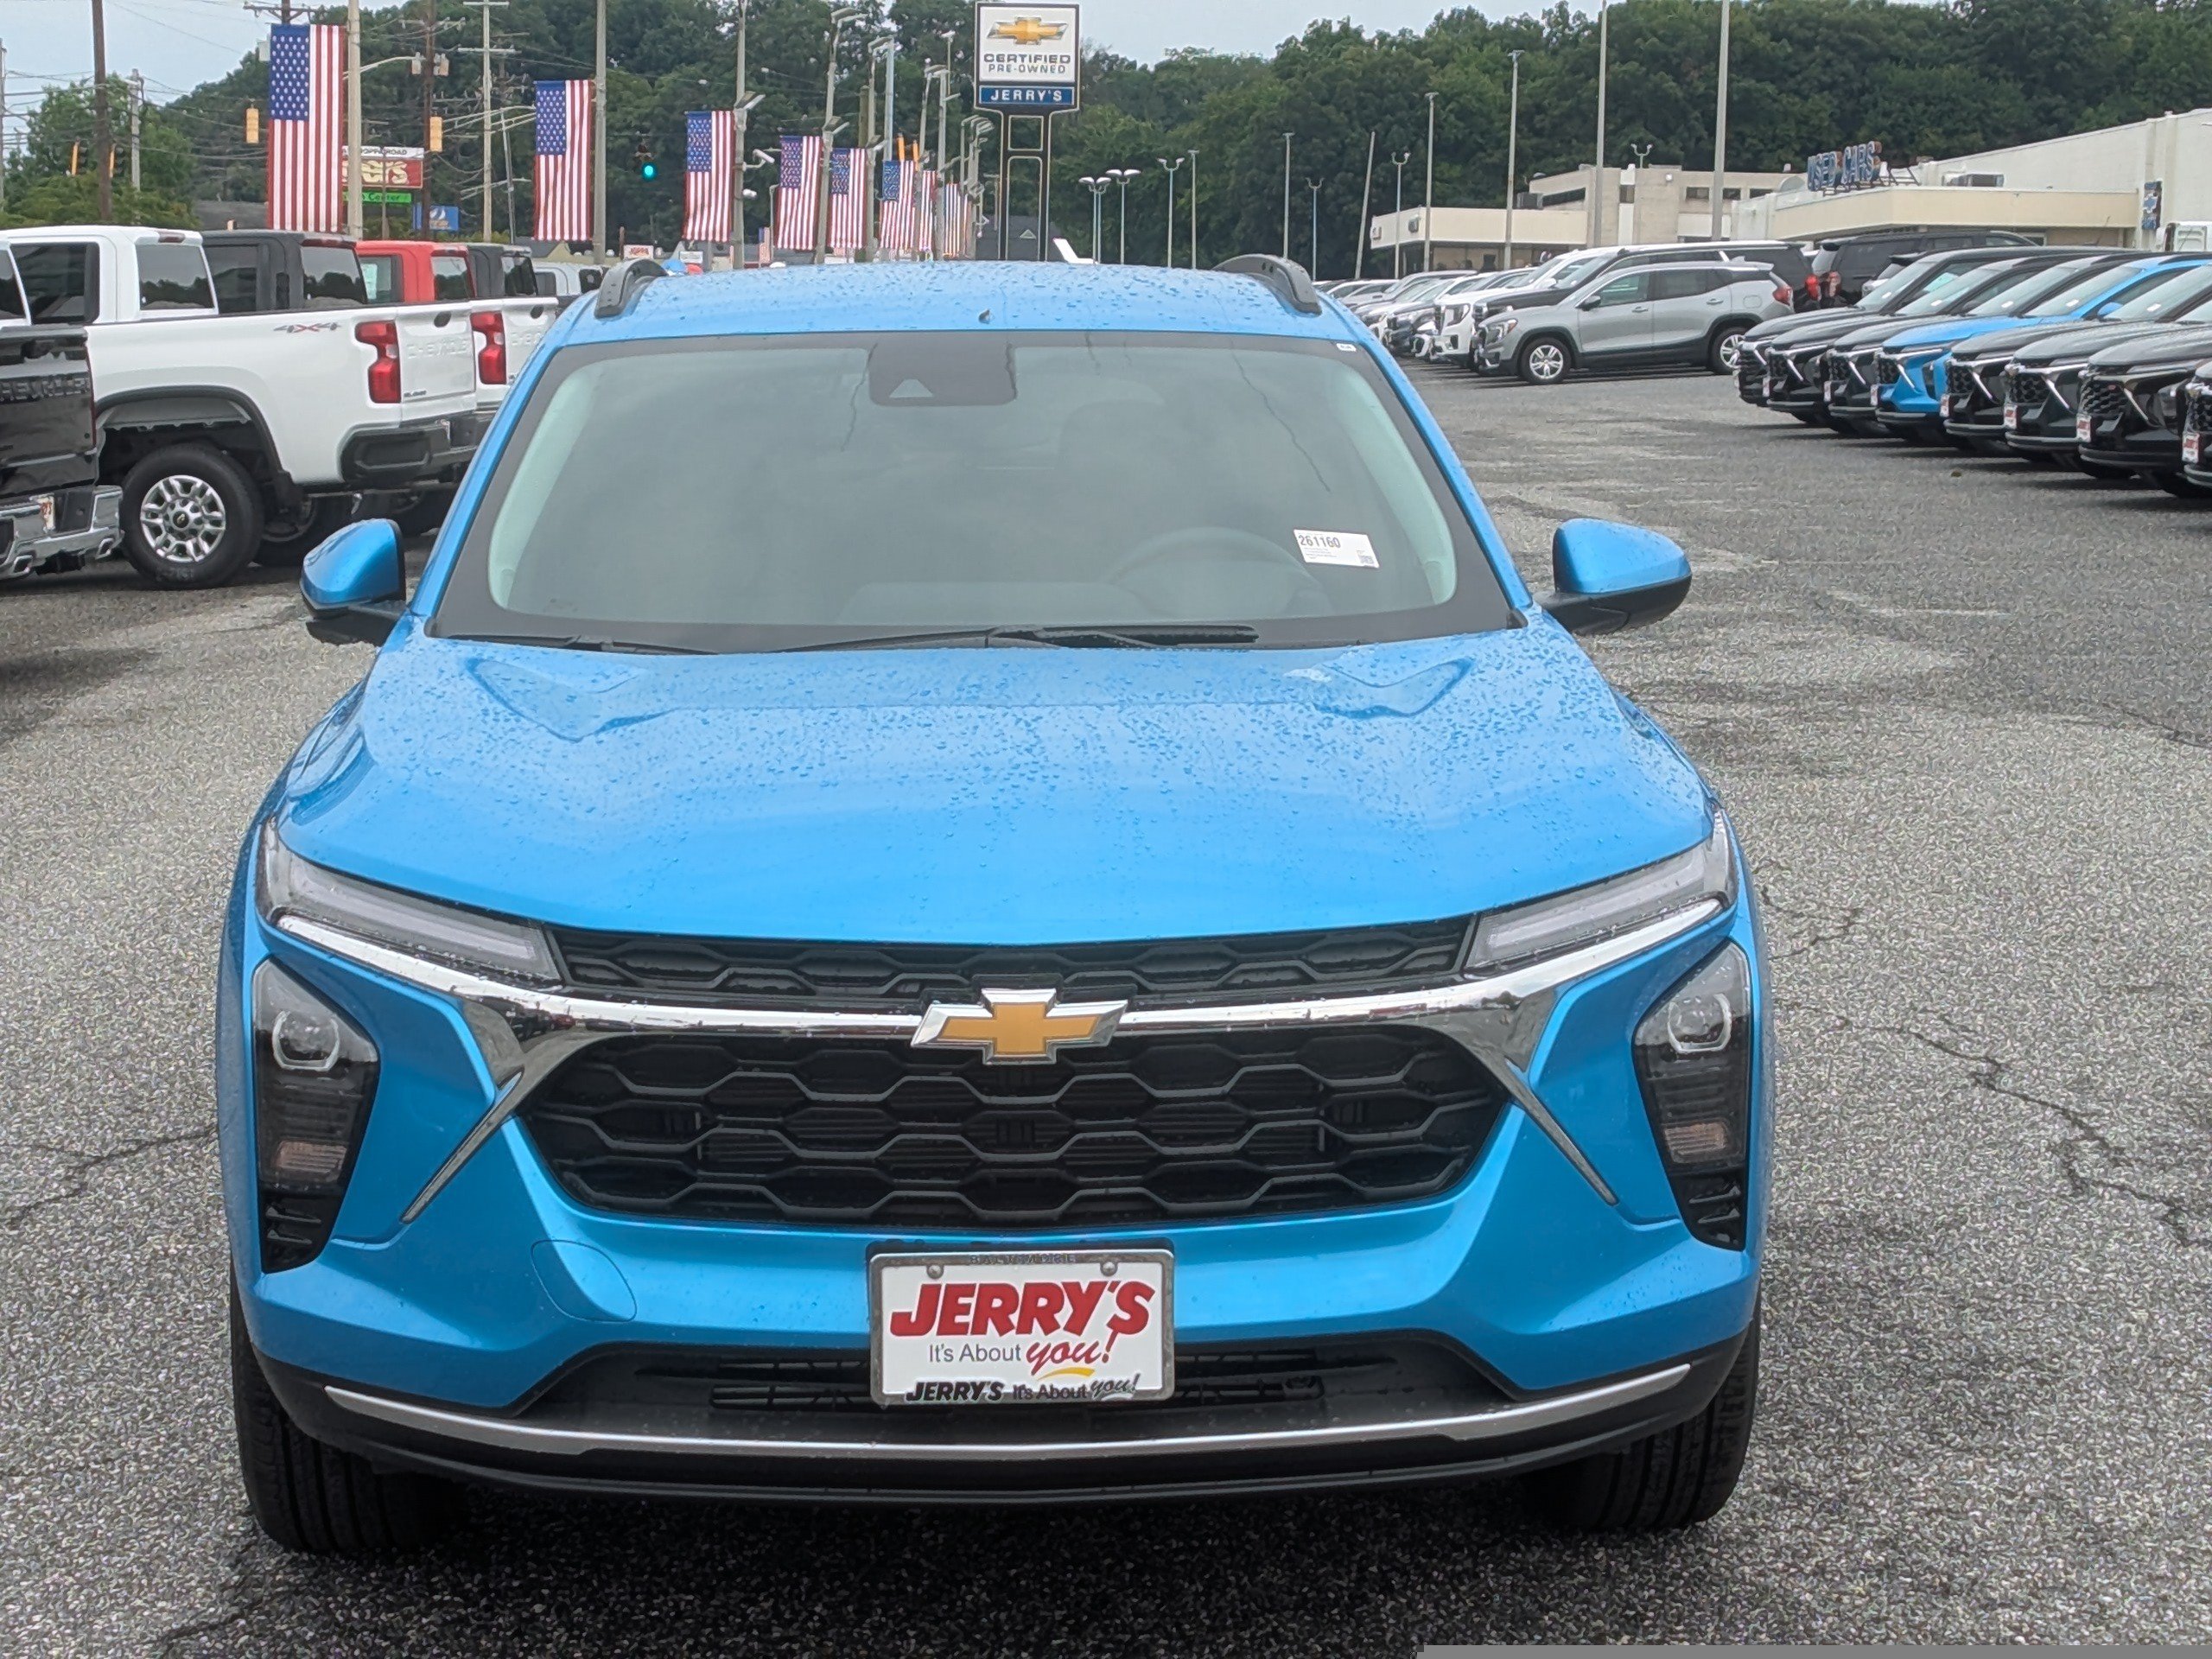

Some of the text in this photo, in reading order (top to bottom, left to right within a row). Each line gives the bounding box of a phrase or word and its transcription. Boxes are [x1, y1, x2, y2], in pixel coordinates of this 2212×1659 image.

[983, 53, 1071, 64] CERTIFIED
[988, 63, 1066, 73] PRE-OWNED
[990, 89, 1062, 101] JERRY'S
[1807, 141, 1880, 192] USED CARS
[1299, 535, 1341, 548] 261160
[890, 1281, 1155, 1337] JERRY'S
[929, 1329, 1120, 1376] It's About you!
[906, 1373, 1141, 1401] JERRY'S It's About you!
